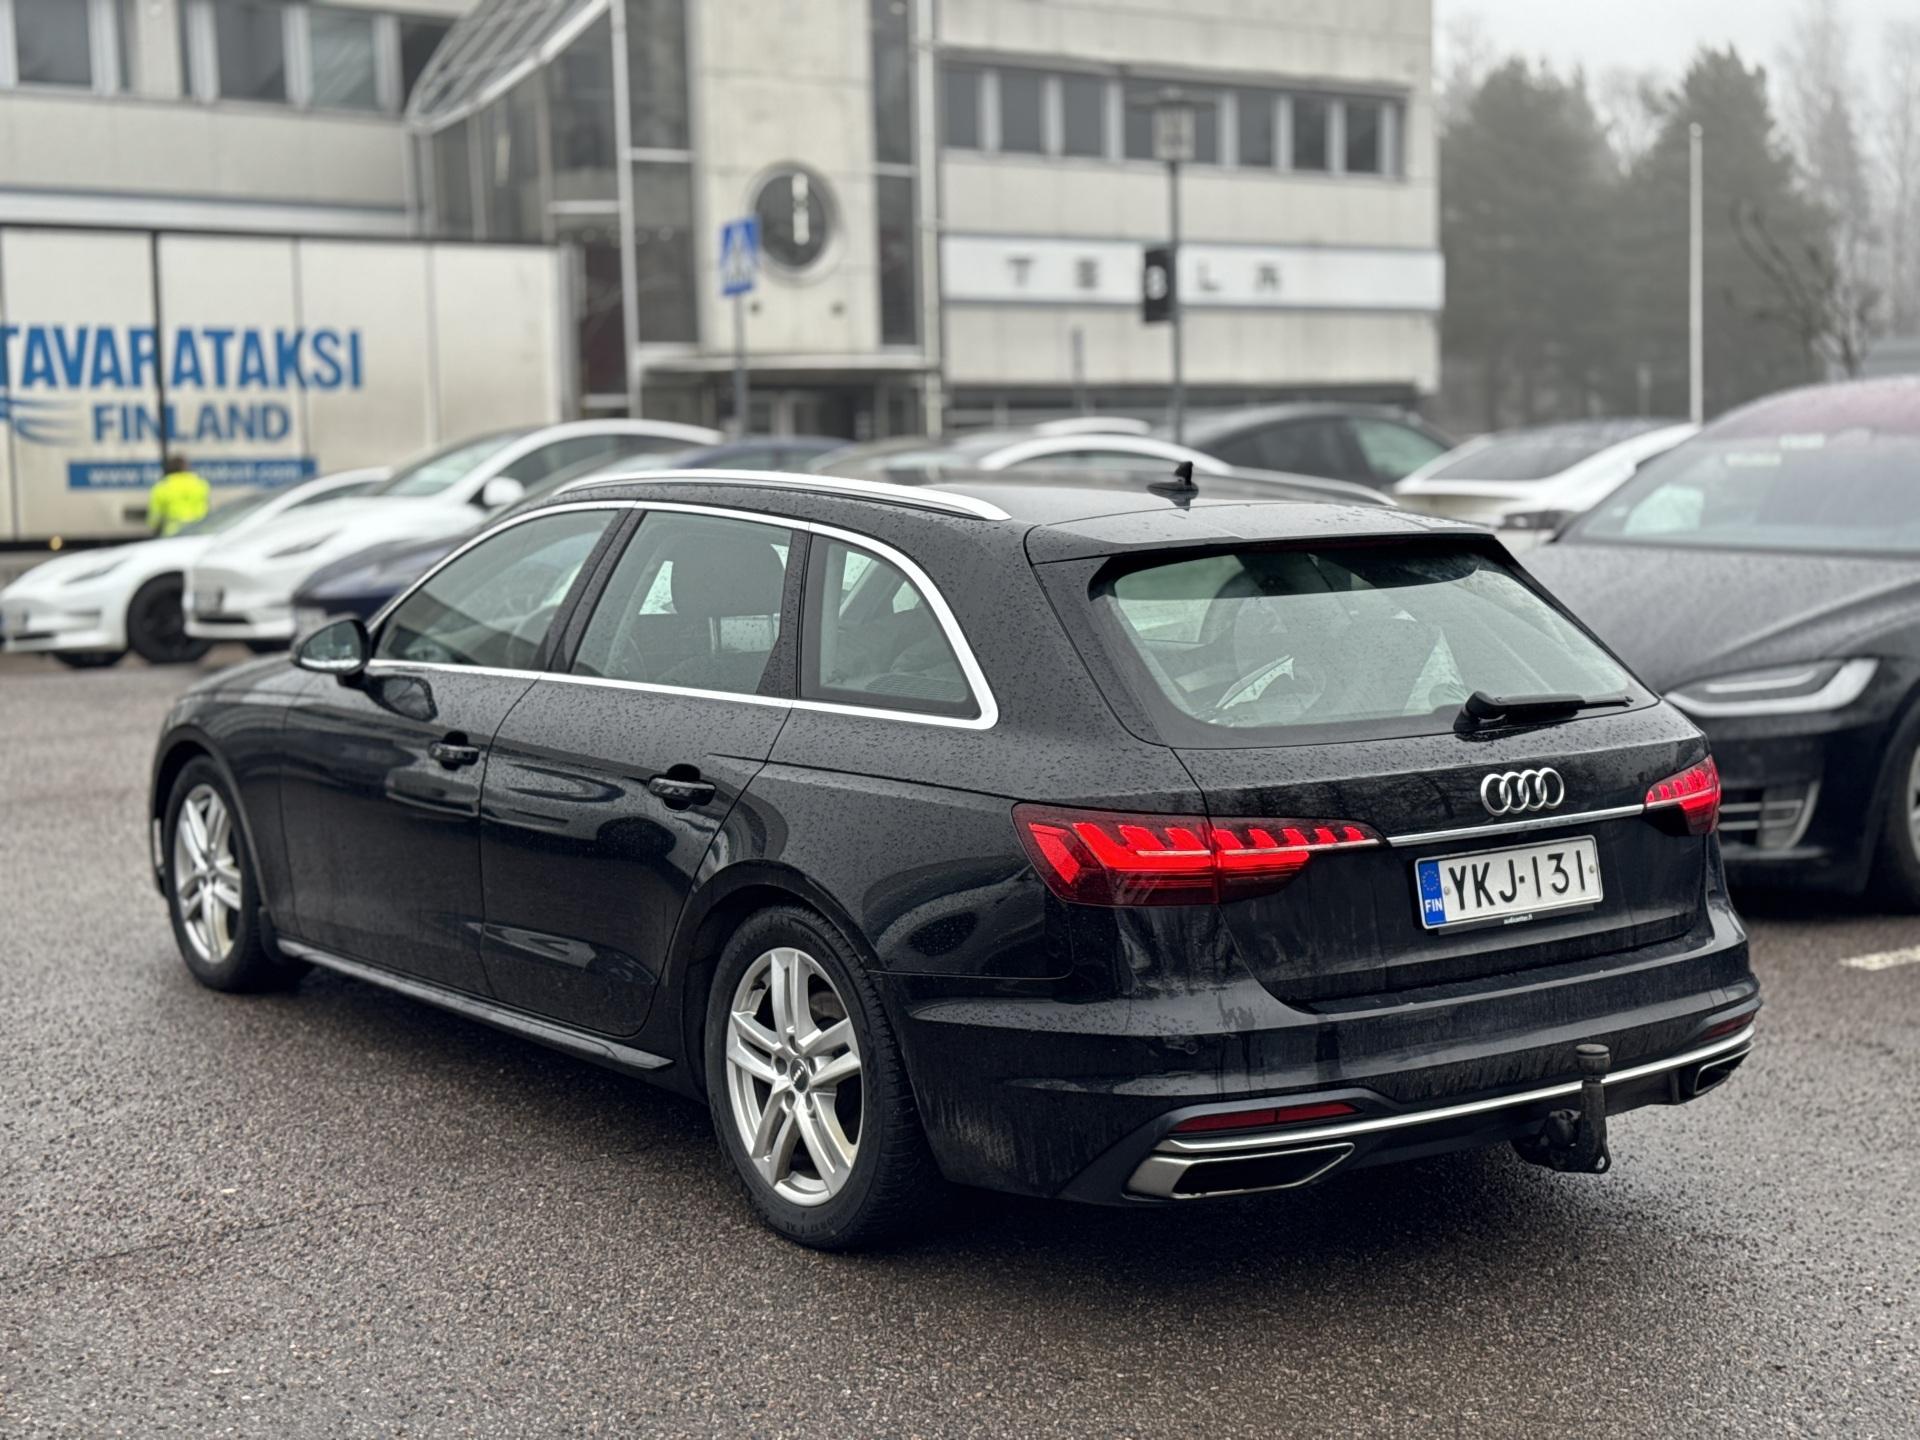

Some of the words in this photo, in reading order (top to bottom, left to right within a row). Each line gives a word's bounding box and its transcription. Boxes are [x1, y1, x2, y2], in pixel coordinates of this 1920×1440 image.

[1007, 257, 1281, 293] TELA
[0, 325, 363, 391] TAVARATAKSI
[93, 403, 291, 442] FINLAND
[1448, 850, 1586, 911] YKJ-131
[1425, 897, 1443, 914] FIN
